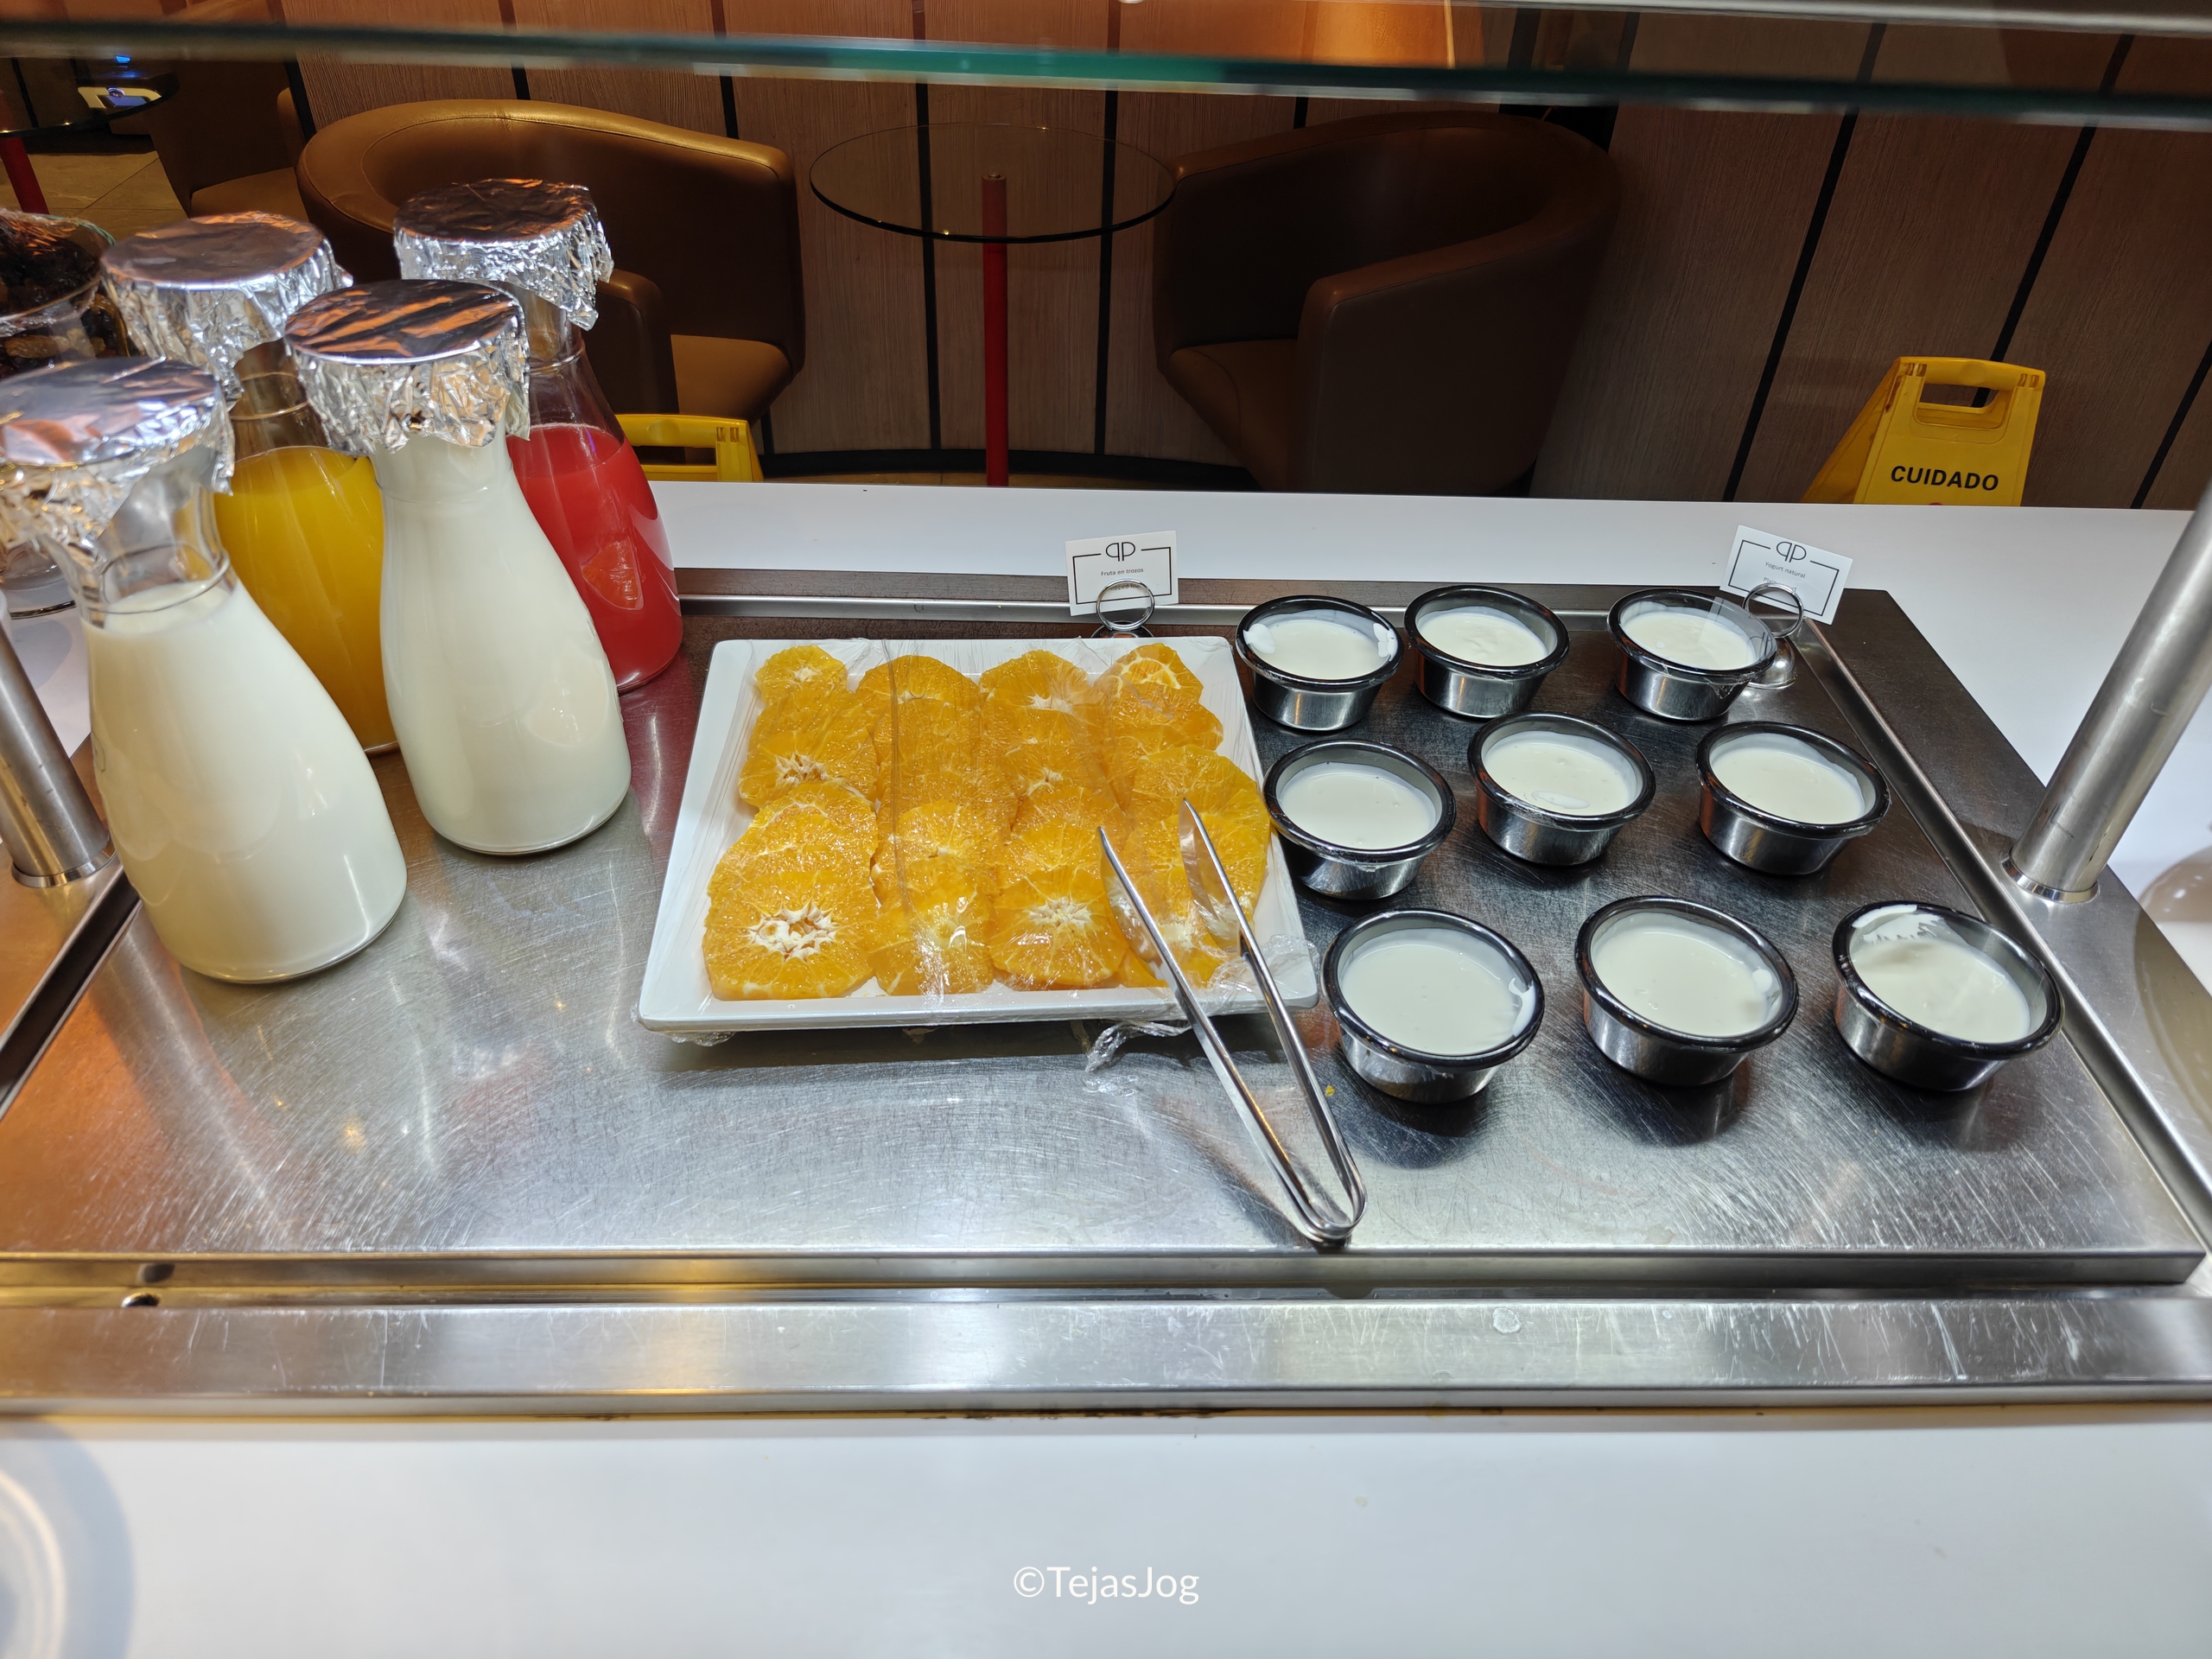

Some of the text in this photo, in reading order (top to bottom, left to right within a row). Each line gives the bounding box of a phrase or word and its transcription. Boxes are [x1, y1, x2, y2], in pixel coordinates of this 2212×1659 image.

[1891, 465, 1999, 491] CUIDADO
[1764, 562, 1806, 578] Yogurt natural
